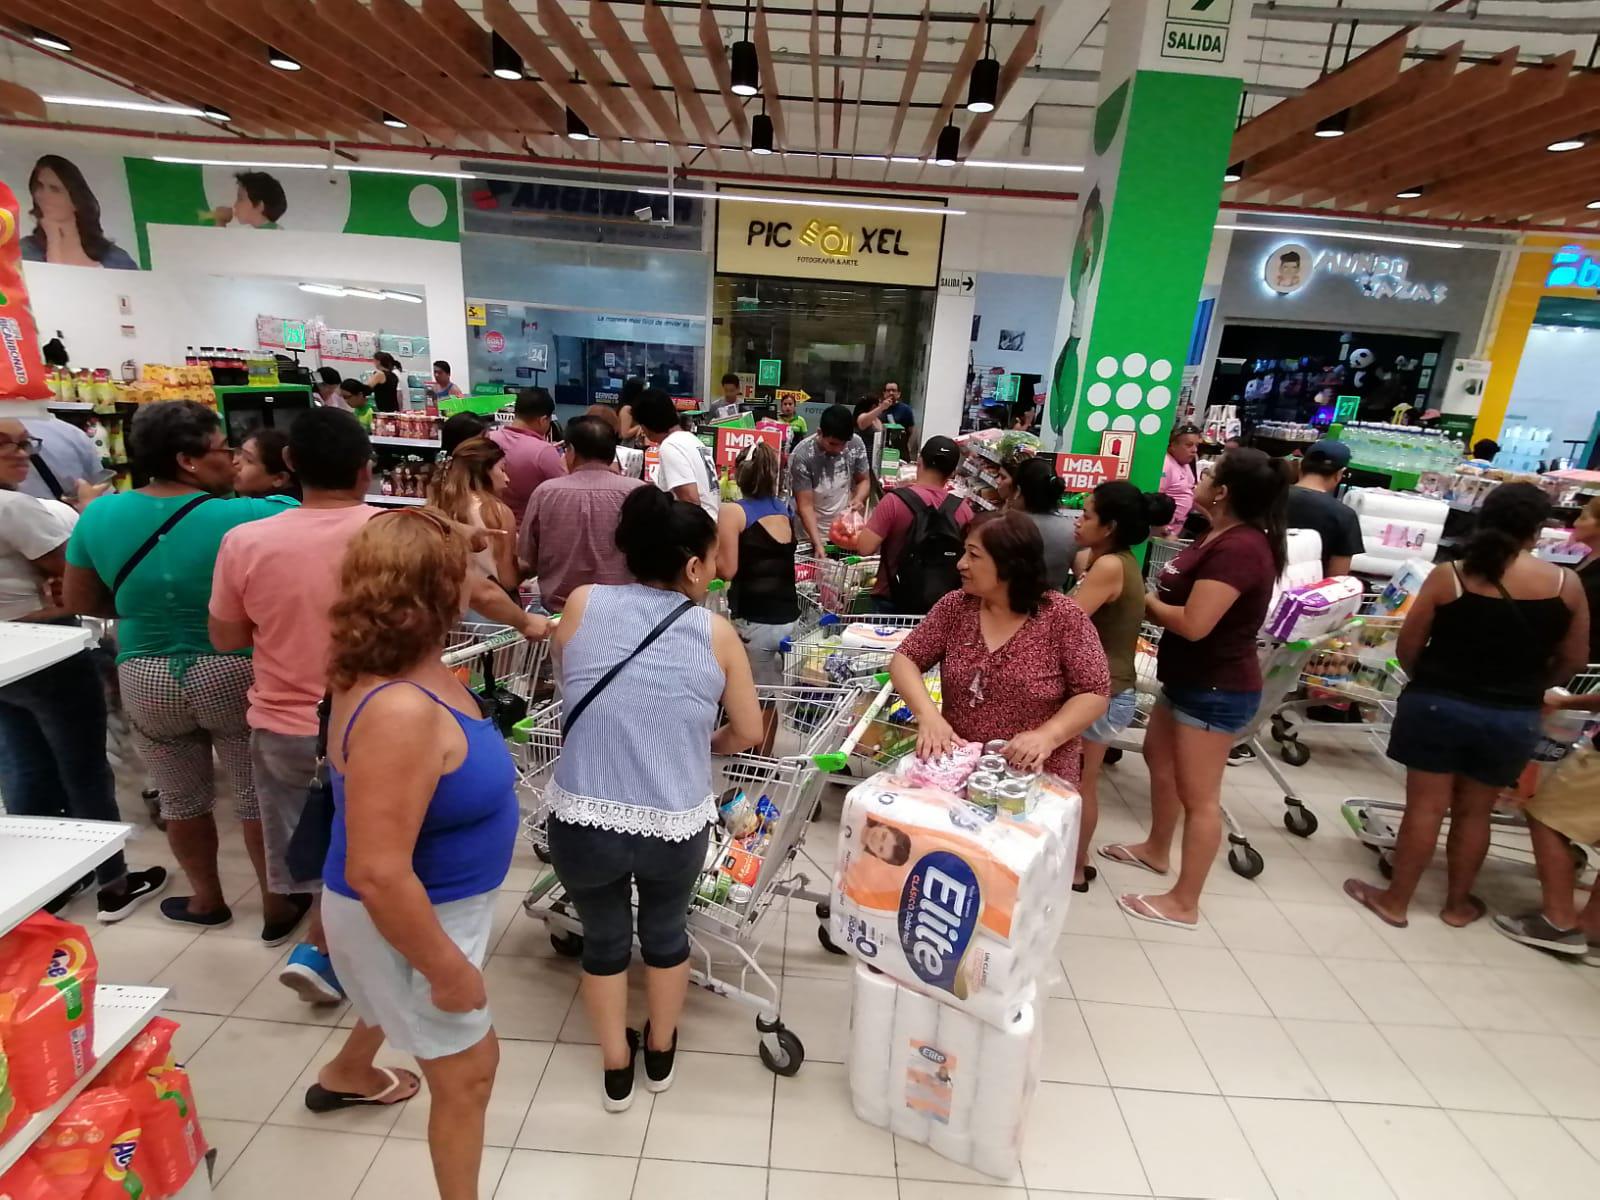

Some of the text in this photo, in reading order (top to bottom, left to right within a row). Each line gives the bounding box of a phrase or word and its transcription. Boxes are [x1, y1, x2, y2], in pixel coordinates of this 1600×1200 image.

[1167, 31, 1221, 53] SALIDA
[747, 220, 909, 256] PIC XEL
[941, 277, 960, 288] SALIDA
[595, 392, 619, 400] SERVICIO
[1340, 402, 1355, 416] 27
[1062, 458, 1104, 474] IMBA
[913, 866, 967, 976] Elite
[921, 1047, 946, 1063] Elite
